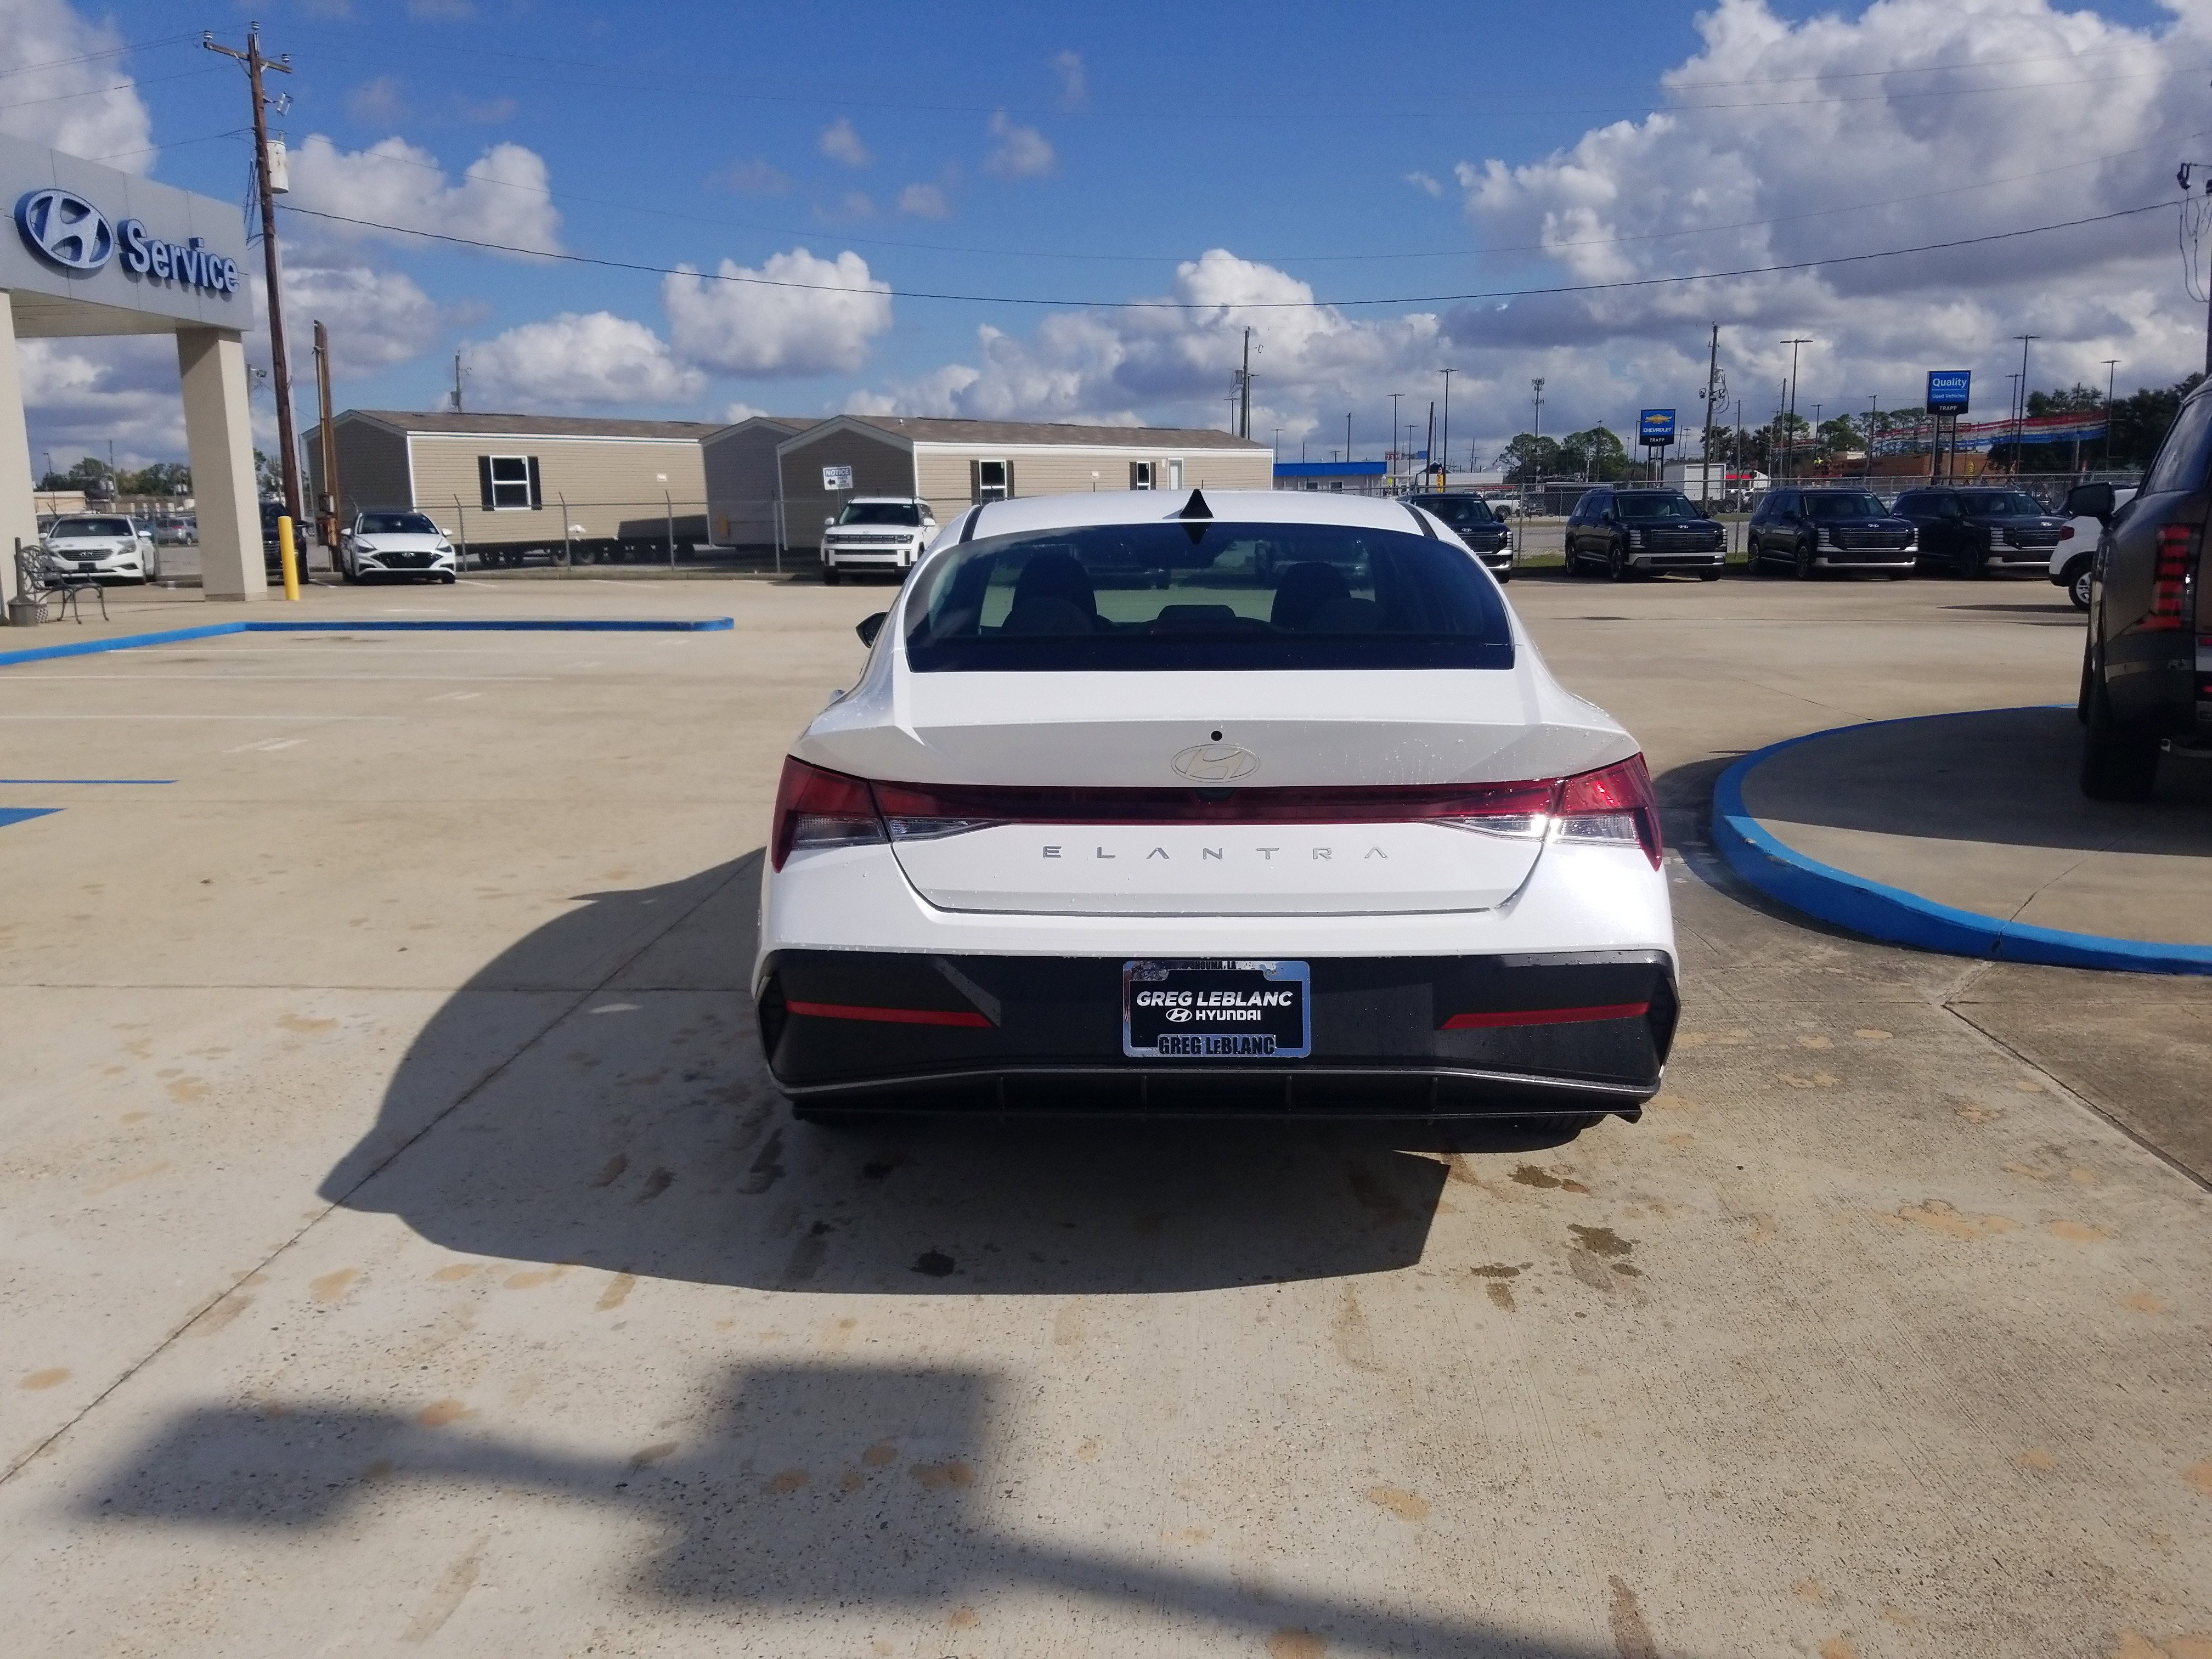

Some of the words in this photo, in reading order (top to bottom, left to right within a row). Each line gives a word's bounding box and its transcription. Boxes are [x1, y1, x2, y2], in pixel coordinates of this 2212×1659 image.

[117, 218, 240, 293] Service
[1932, 377, 1967, 388] Quality
[1043, 846, 1387, 860] ELANTRA
[1227, 961, 1236, 969] LA
[1136, 991, 1193, 1006] GREG
[1197, 991, 1293, 1006] LEBLANC
[1195, 1009, 1261, 1020] HYUNDAI
[1159, 1036, 1201, 1054] GREG
